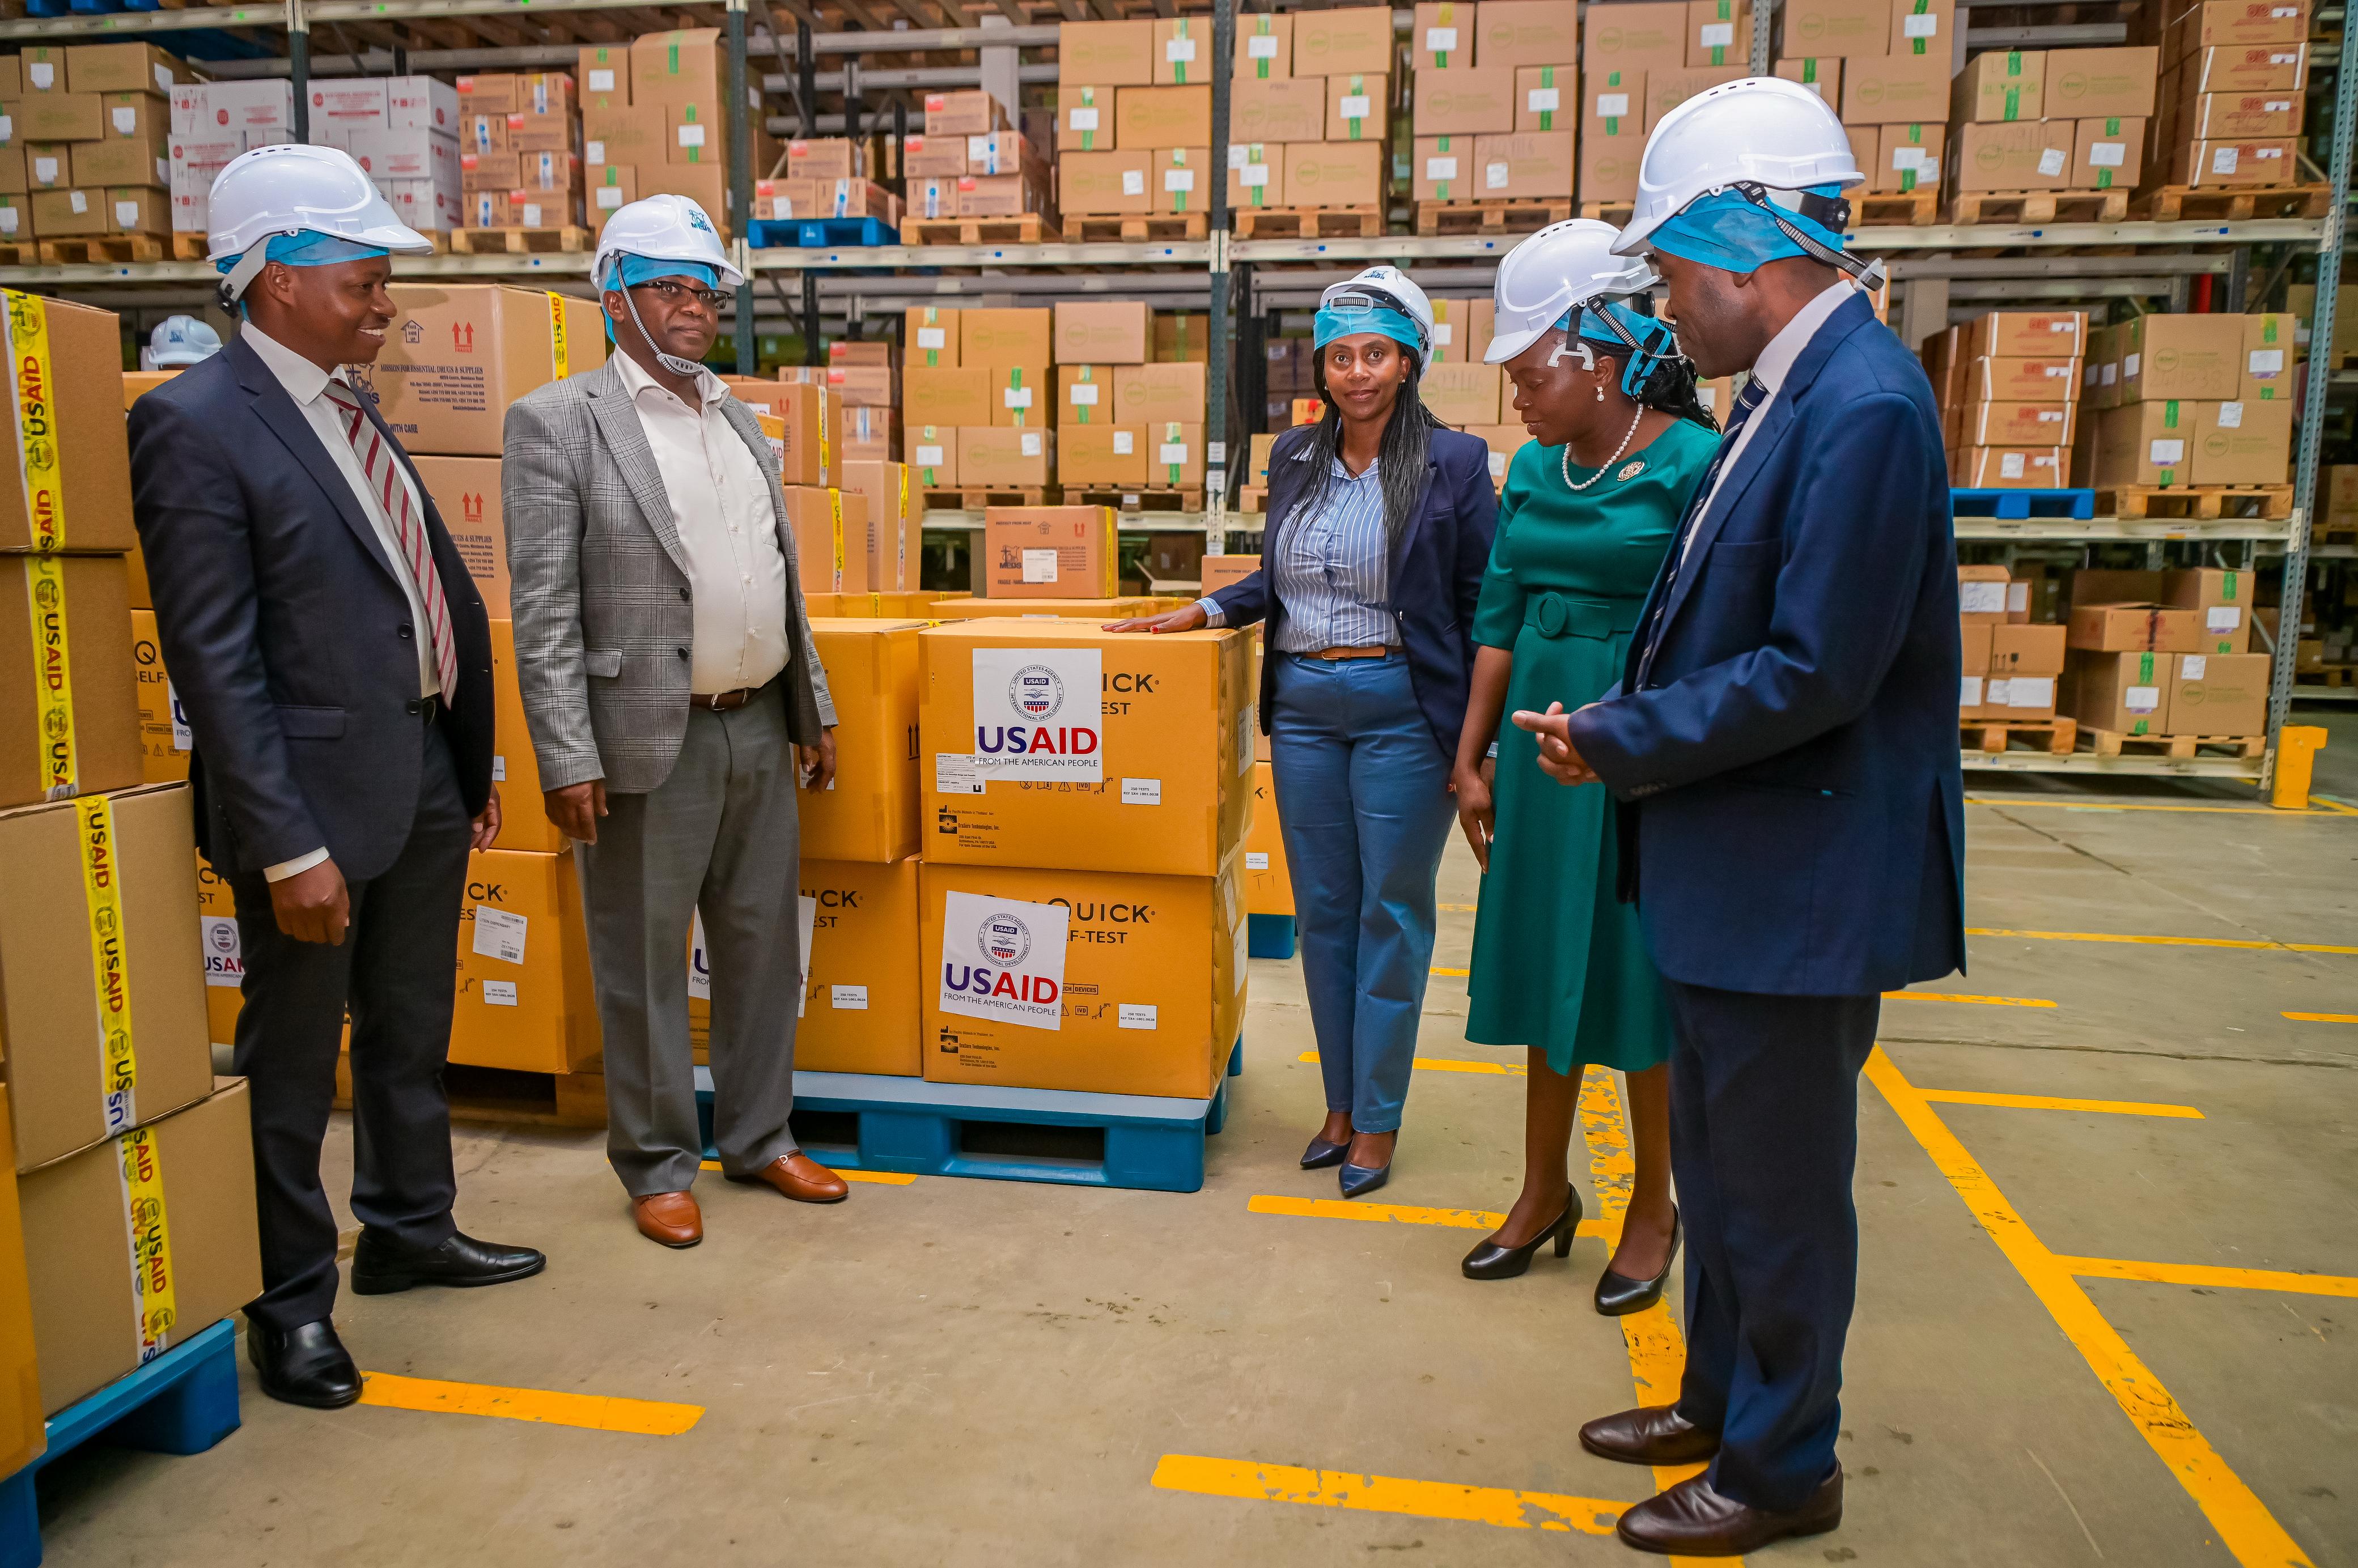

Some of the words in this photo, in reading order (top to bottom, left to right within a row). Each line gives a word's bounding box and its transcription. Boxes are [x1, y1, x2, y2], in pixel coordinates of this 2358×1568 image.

[23, 356, 46, 436] USAID
[389, 424, 403, 432] WITH
[404, 424, 418, 433] CARE
[44, 613, 62, 691] USAID
[1012, 669, 1027, 684] UNITED
[1044, 669, 1060, 684] AGENCY
[1010, 693, 1038, 720] INTERNATIONAL
[1039, 693, 1062, 720] DEVELOPMENT
[978, 726, 1097, 754] USAID
[89, 811, 110, 889] USAID
[982, 916, 996, 929] UNITED
[1014, 919, 1028, 935] AGENCY
[1067, 930, 1128, 944] F-TEST
[979, 937, 1004, 966] INTERNATIONAL
[1005, 944, 1029, 966] DEVELOPMENT
[103, 937, 124, 1013] USAID
[945, 963, 1058, 1004] USAID
[944, 992, 965, 1002] FROM
[967, 996, 982, 1005] THE
[983, 999, 1025, 1012] AMERICAN
[1028, 1006, 1056, 1016] PEOPLE
[133, 1129, 153, 1183] SAID
[148, 1225, 167, 1294] USAID
